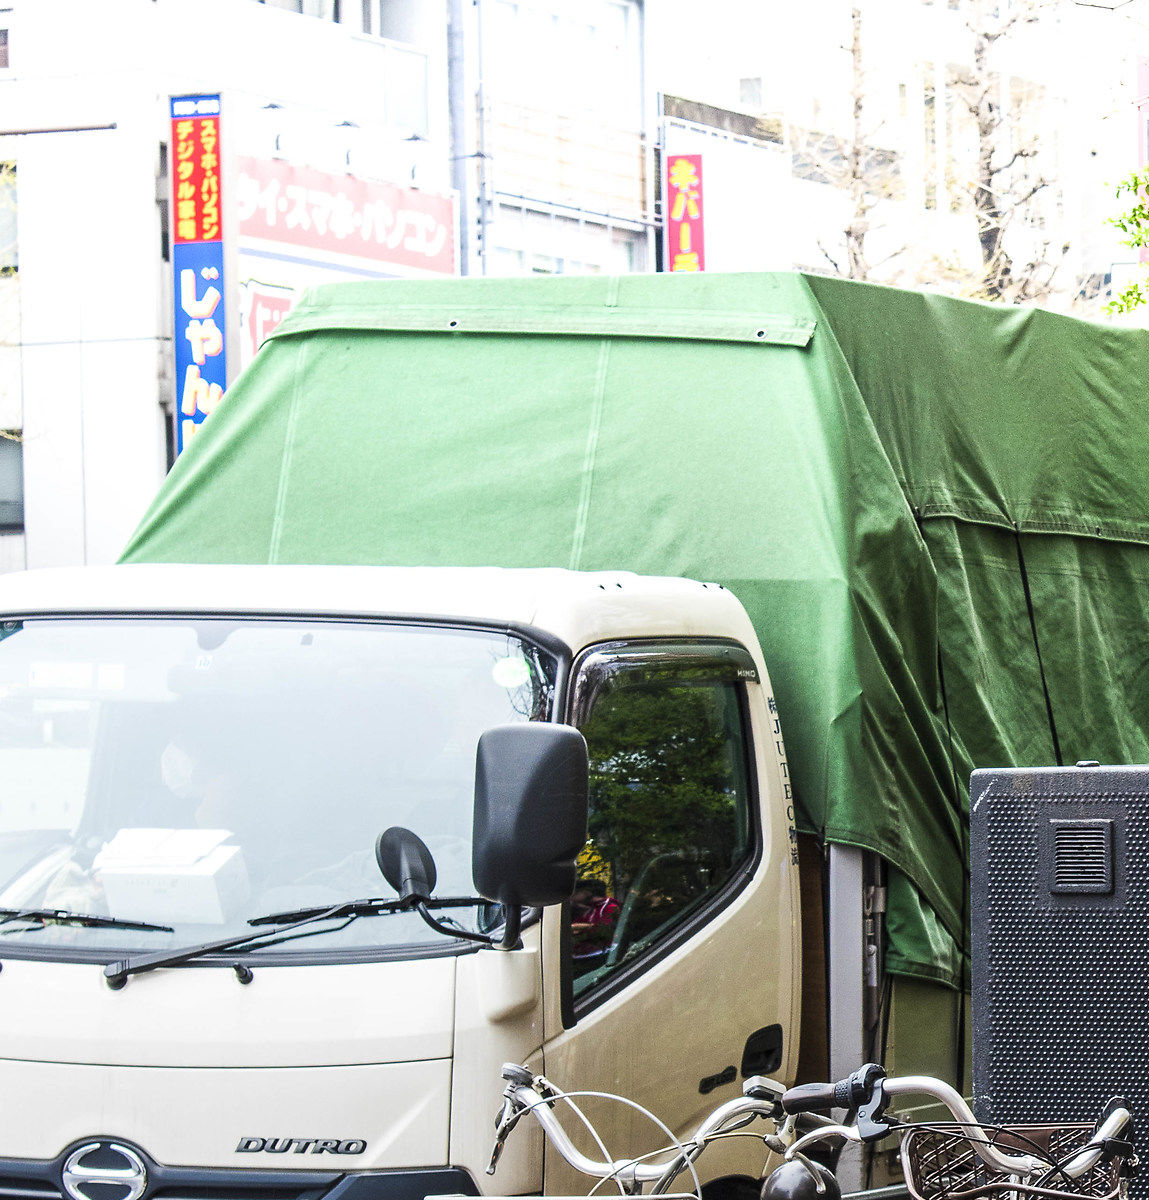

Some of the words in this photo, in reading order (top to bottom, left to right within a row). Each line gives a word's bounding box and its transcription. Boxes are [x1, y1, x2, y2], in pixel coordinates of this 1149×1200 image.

[180, 266, 223, 449] じゃん
[235, 1137, 368, 1155] DUTRO
